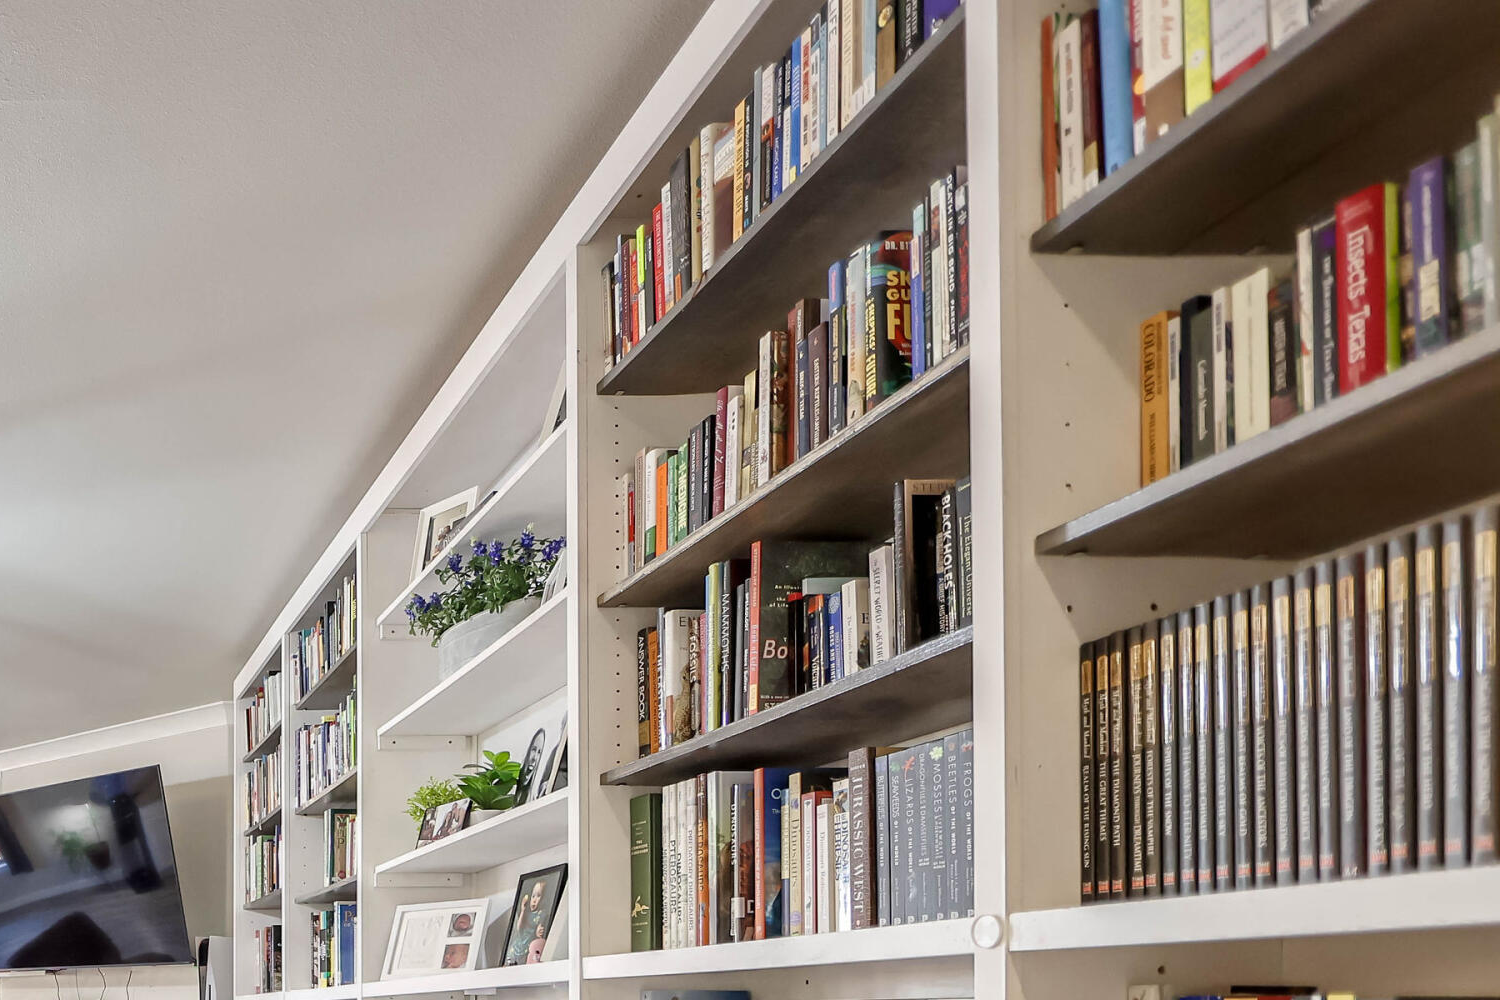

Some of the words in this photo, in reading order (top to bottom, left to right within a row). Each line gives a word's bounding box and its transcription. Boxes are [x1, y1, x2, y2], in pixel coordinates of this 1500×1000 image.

[946, 173, 955, 213] DEATH
[946, 216, 955, 230] IN
[946, 233, 955, 255] BIG
[946, 258, 955, 292] BEND
[1347, 223, 1371, 301] Insects
[946, 299, 955, 335] PARENT
[1347, 304, 1371, 364] Texas
[866, 353, 876, 400] FUTURE
[941, 493, 953, 541] BLACK
[964, 514, 973, 533] The
[941, 542, 953, 591] HOLES
[964, 535, 973, 572] Elegant
[964, 574, 973, 617] Universe
[721, 593, 730, 672] MAMMOTHS
[637, 636, 646, 681] ANSWER
[689, 635, 697, 683] FOSSILS
[637, 685, 646, 721] BOOK
[933, 763, 941, 811] MOSSES
[948, 755, 957, 804] BEETLES
[963, 762, 972, 807] FROGS
[1099, 761, 1107, 777] THE
[1113, 759, 1121, 777] THE
[891, 775, 900, 818] SEAWEEDS
[905, 778, 914, 824] LIZARDS
[1099, 779, 1107, 807] GREAT
[1113, 778, 1121, 823] DIAMOND
[851, 776, 864, 859] JURASSIC
[1113, 824, 1121, 847] PATH
[791, 819, 800, 888] Dinosaurs
[851, 864, 864, 913] WEST
